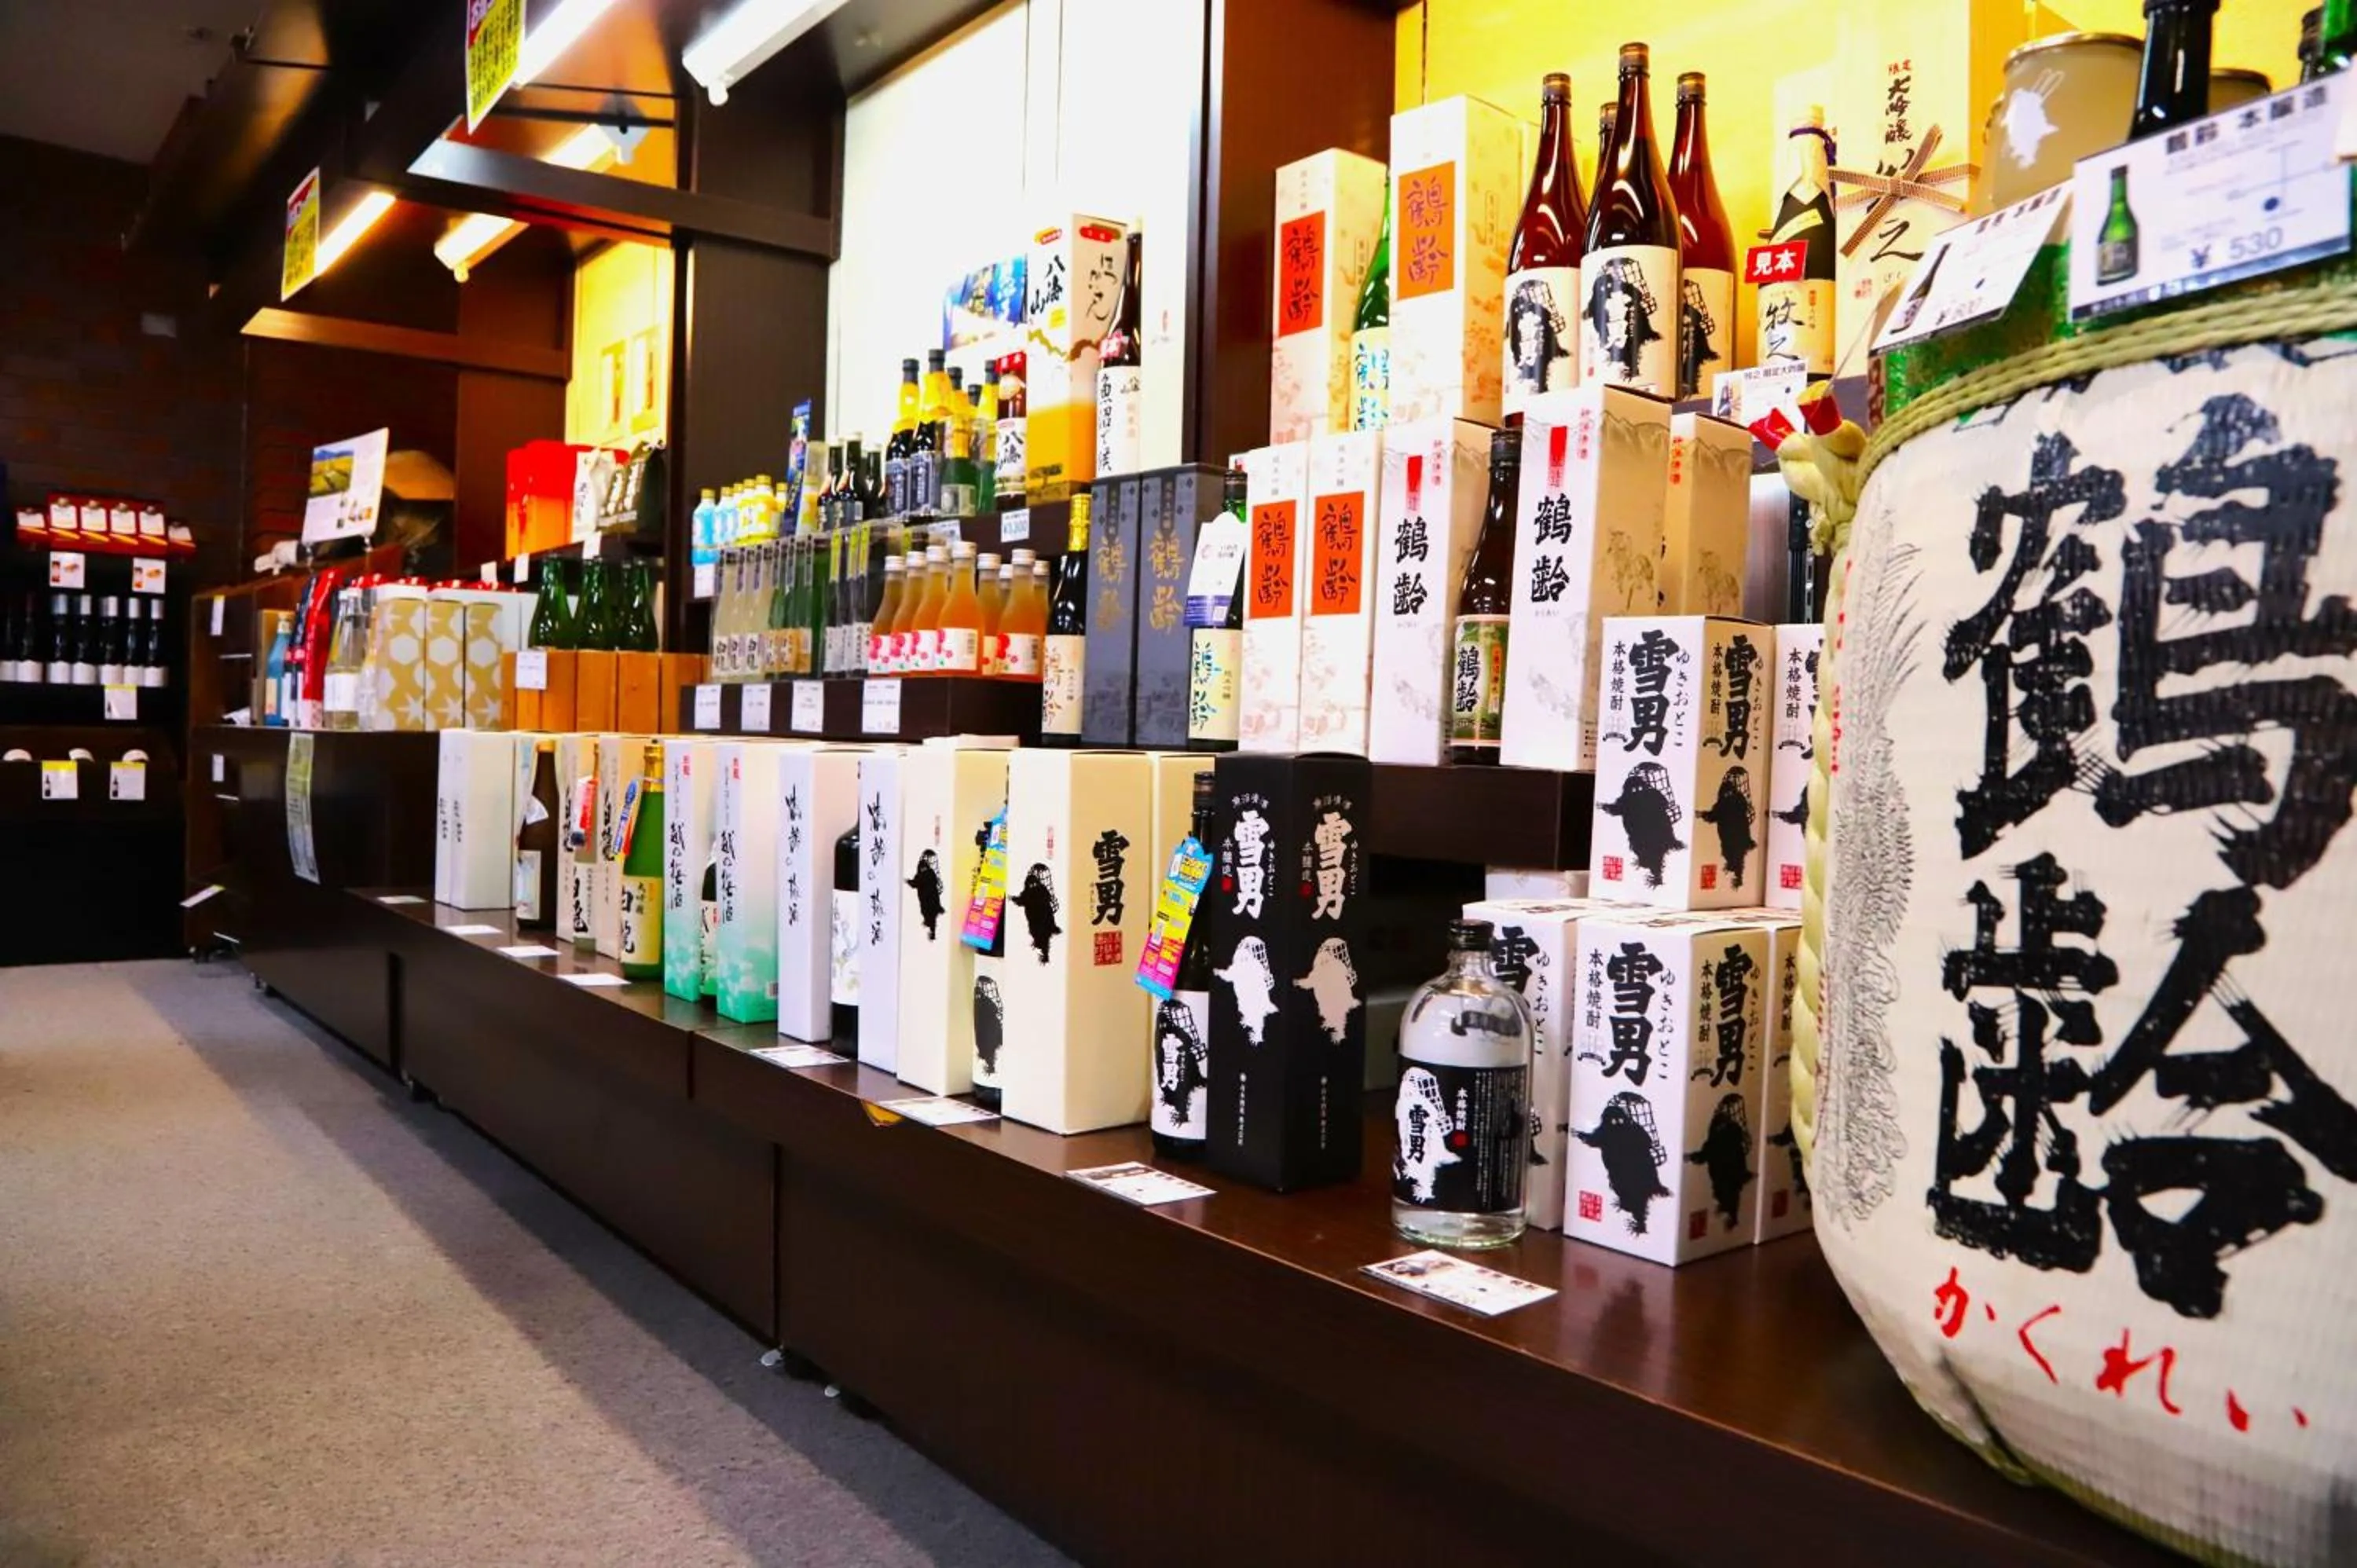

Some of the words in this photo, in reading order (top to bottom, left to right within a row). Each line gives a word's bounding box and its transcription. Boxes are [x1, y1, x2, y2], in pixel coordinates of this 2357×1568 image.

[1886, 76, 1912, 145] 大吟醸
[1753, 249, 1797, 276] 見本
[2230, 227, 2283, 259] 530
[1765, 298, 1805, 361] 牧之
[1394, 516, 1429, 616] 鶴齢
[1531, 493, 1572, 603] 鶴齢
[1456, 646, 1480, 713] 鶴齢
[1611, 640, 1626, 711] 本格焼酎
[1624, 629, 1680, 757] 雪男
[1673, 652, 1689, 747] ゆきおとこ
[1710, 643, 1723, 716] 本格焼酎
[1720, 634, 1758, 760] 雪男
[1785, 647, 1802, 720] 本格焼酎
[1092, 830, 1131, 926] 雪男
[1232, 810, 1270, 920] 雪男
[1311, 811, 1352, 921] 雪男
[1585, 949, 1604, 1029] 本格焼酎
[1601, 943, 1664, 1086] 雪男
[1657, 968, 1676, 1079] ゆきおとこ
[1698, 961, 1714, 1042] 本格焼酎
[1710, 944, 1754, 1087] 雪男
[1407, 1104, 1430, 1164] 雪男
[1933, 1266, 2309, 1431] かくれい
